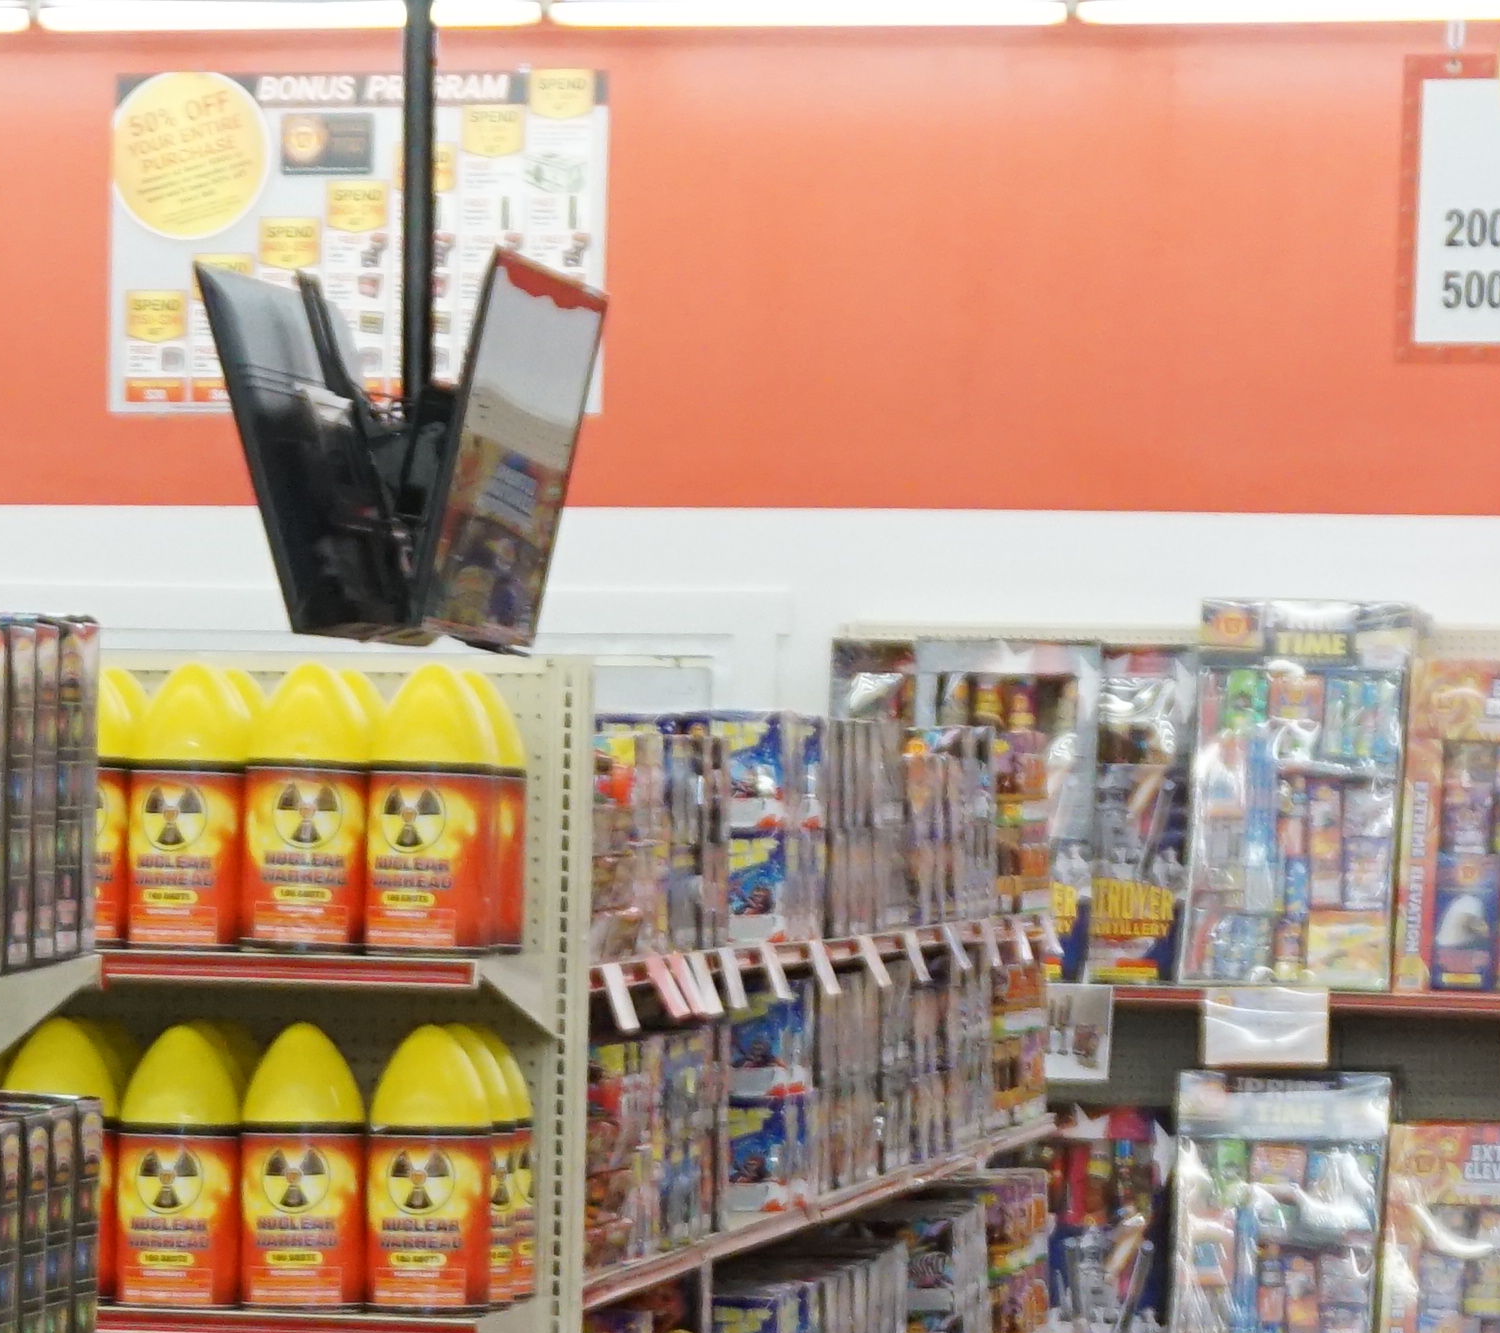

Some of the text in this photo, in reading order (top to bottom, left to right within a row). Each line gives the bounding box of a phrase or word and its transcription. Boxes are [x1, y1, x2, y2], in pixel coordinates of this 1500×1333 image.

[258, 74, 509, 100] BONUS PRGRAM
[539, 77, 587, 90] SPEND
[185, 90, 228, 121] OFF
[469, 110, 517, 122] SPEND
[334, 189, 382, 201] SPEND
[267, 226, 313, 238] SPEND
[1277, 632, 1347, 655] TIME
[1095, 879, 1174, 921] TROYER
[130, 1216, 208, 1232] NUCLEAR
[256, 1215, 336, 1231] NUCLEAR
[381, 1217, 461, 1233] NUCLEAR
